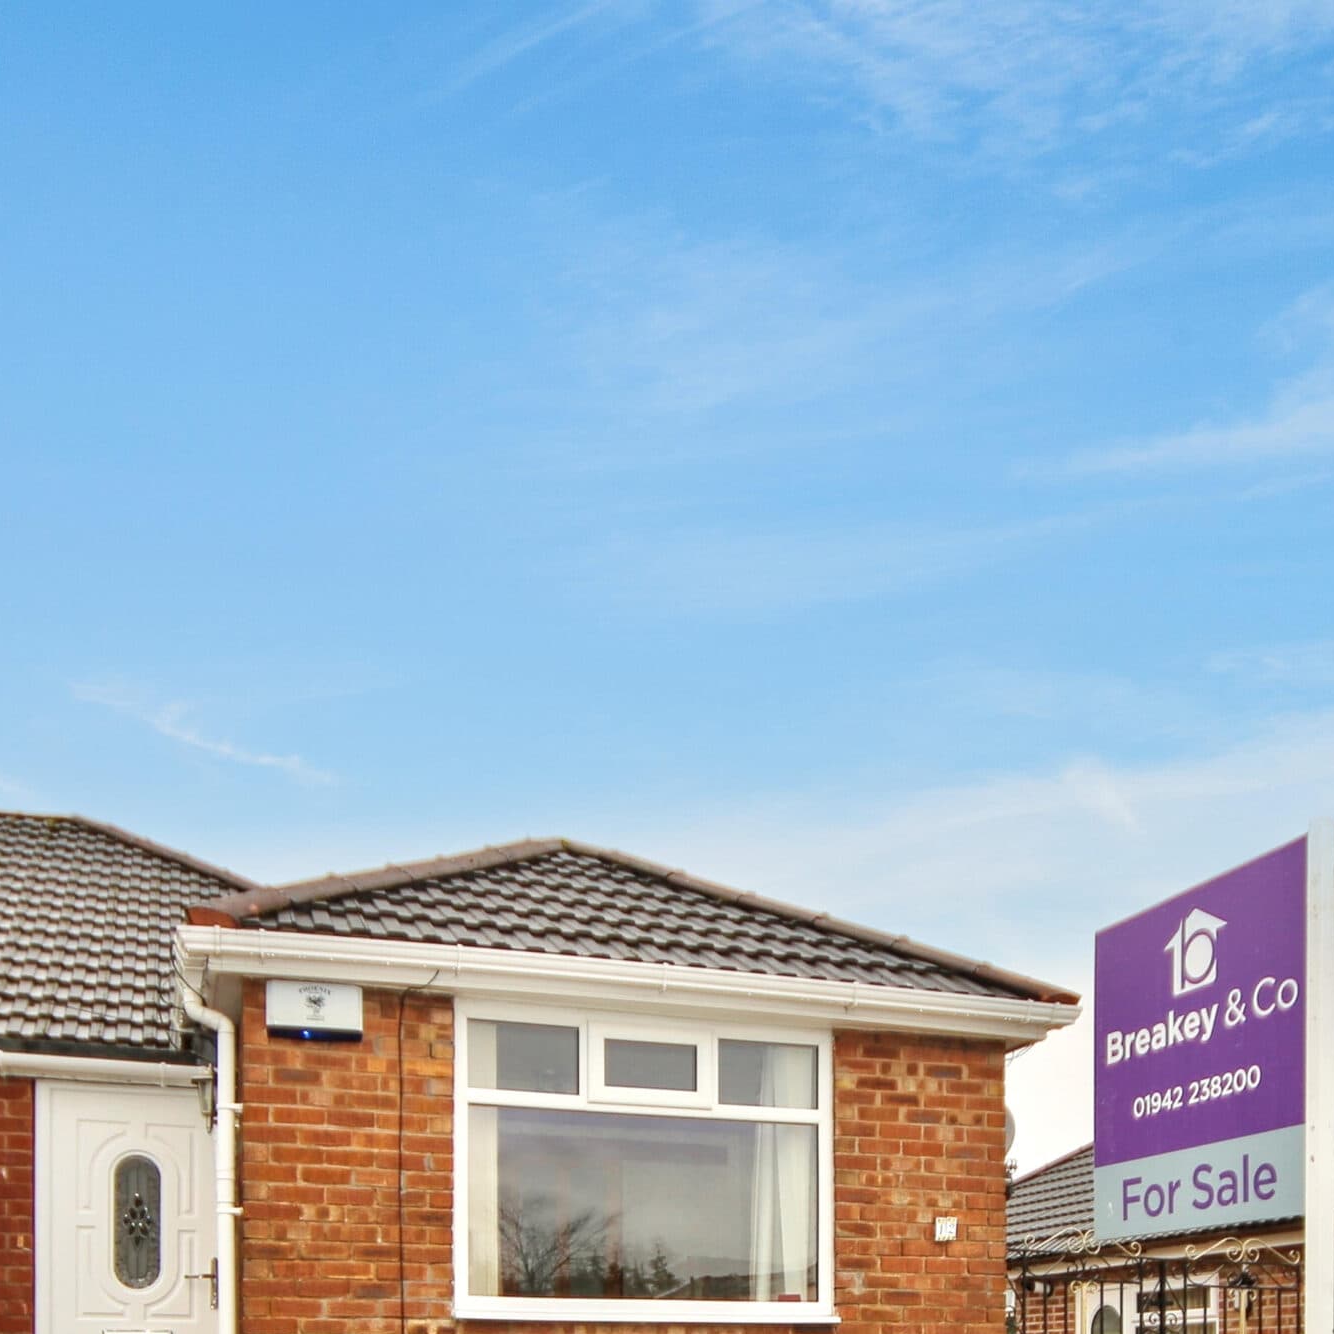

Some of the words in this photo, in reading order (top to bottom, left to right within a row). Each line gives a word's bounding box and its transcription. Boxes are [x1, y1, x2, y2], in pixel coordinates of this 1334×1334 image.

[1107, 1004, 1218, 1065] Breakey
[1224, 988, 1246, 1028] &
[1253, 976, 1299, 1018] Co
[1133, 1086, 1183, 1118] 01942
[1188, 1065, 1261, 1105] 238200
[1122, 1176, 1181, 1221] For
[1192, 1153, 1278, 1210] Sale
